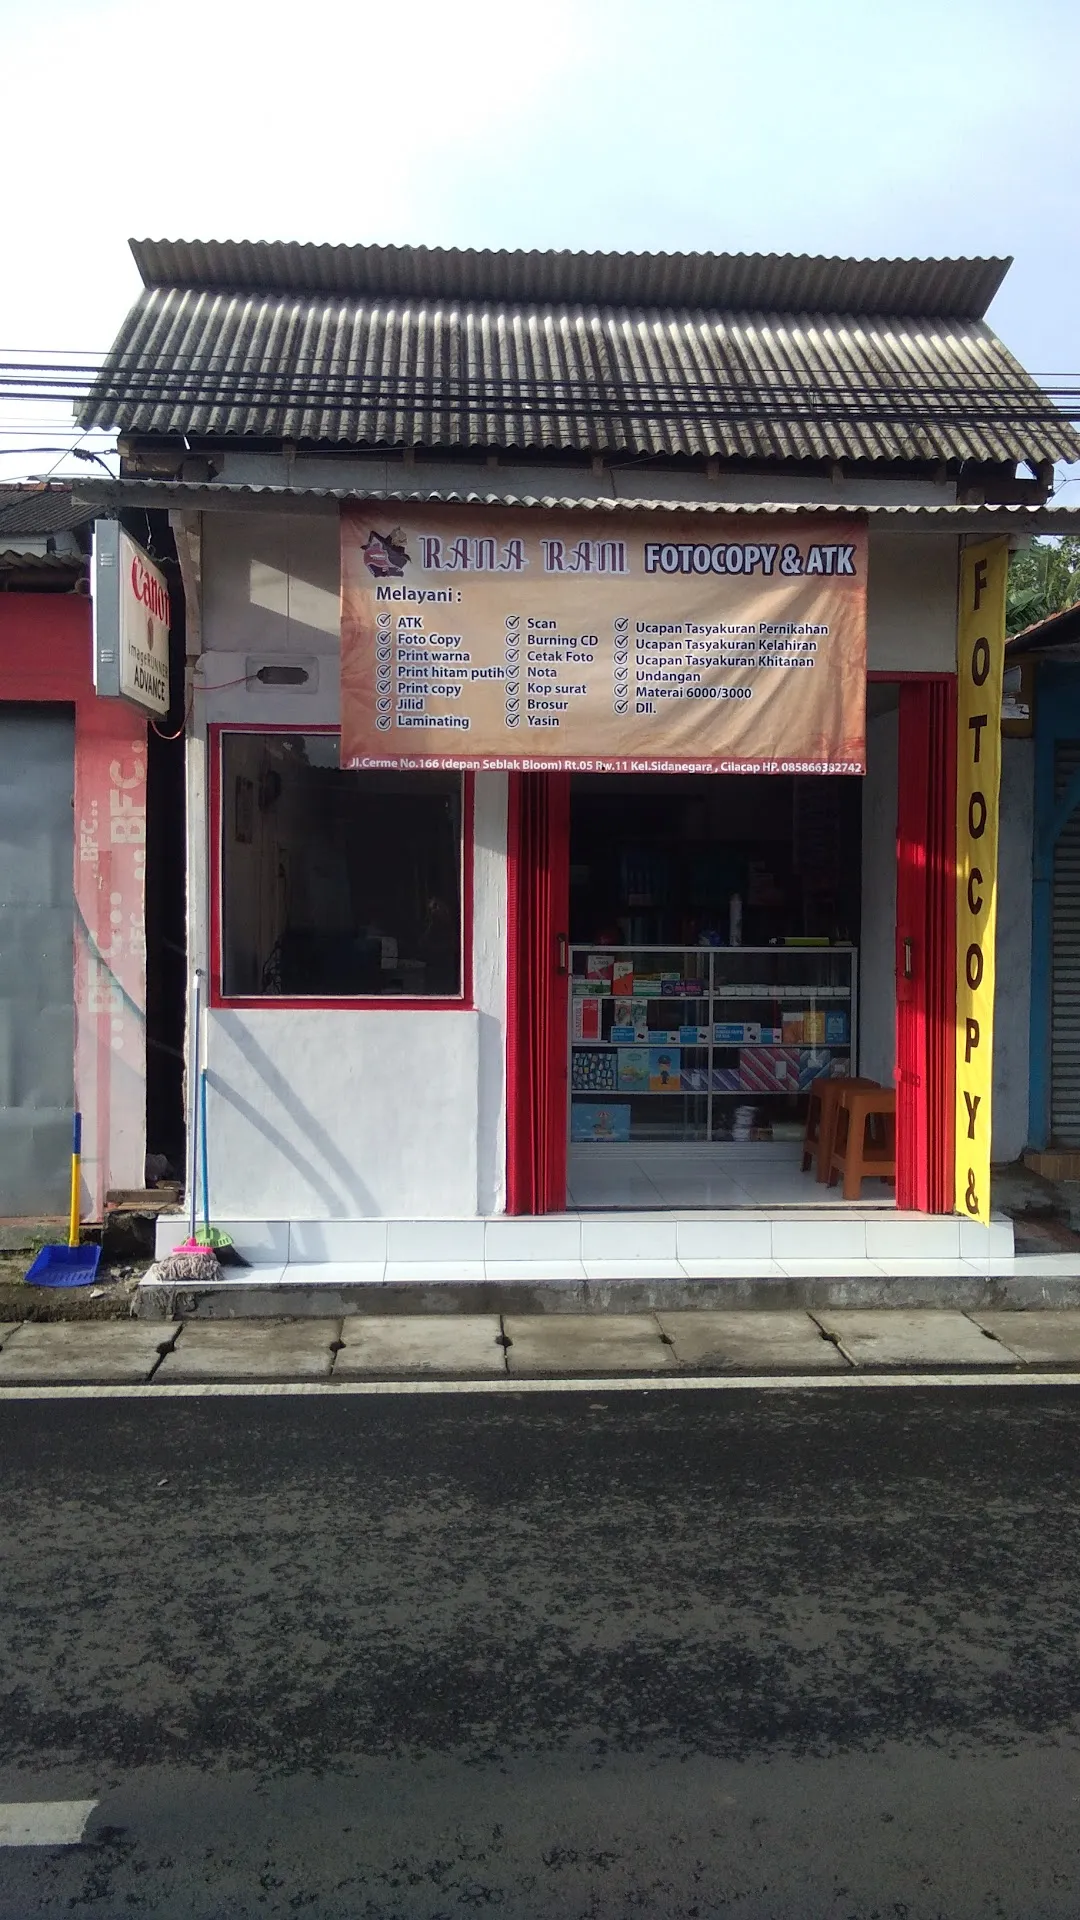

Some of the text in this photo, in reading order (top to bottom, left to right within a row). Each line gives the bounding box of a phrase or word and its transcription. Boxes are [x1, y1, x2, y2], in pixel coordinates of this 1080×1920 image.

[417, 536, 856, 576] RANA RANI FOTOCOPY & ATK
[131, 555, 172, 630] Canon
[376, 586, 453, 604] Melayani
[398, 617, 423, 628] ATK
[527, 618, 557, 629] Scan
[636, 622, 828, 637] Ucapan Tasyakuran Pernikahan
[398, 634, 461, 648] Foto Copy
[527, 635, 599, 649] Burning CD
[636, 640, 817, 653] Ucapan Tasyakuran Kelahiran
[398, 650, 470, 662] Print warna
[527, 651, 594, 662] Cetak Foto
[636, 656, 814, 669] Ucapan Tasyakuran Khitanan
[398, 667, 505, 681] Print hitam putih
[527, 667, 557, 678] Nota
[636, 671, 701, 684] Undangan
[133, 664, 165, 701] ADVANCE
[398, 683, 461, 697] Print copy
[527, 684, 587, 696] Kop surat
[636, 687, 752, 699] Materai 6000/3000
[397, 699, 424, 711] Jilid
[527, 700, 569, 711] Brosur
[636, 703, 657, 714] Dll.
[398, 716, 470, 729] Laminating
[527, 716, 560, 727] Yasin
[350, 758, 397, 768] Jl.Cerme
[400, 759, 440, 769] No.166
[441, 759, 480, 771] (depan
[483, 759, 521, 770] Seblak
[523, 760, 562, 771] Bloom)
[565, 761, 593, 770] Rt.05
[596, 761, 628, 771] Rw.11
[721, 762, 760, 773] Cilacap
[763, 762, 779, 772] HP.
